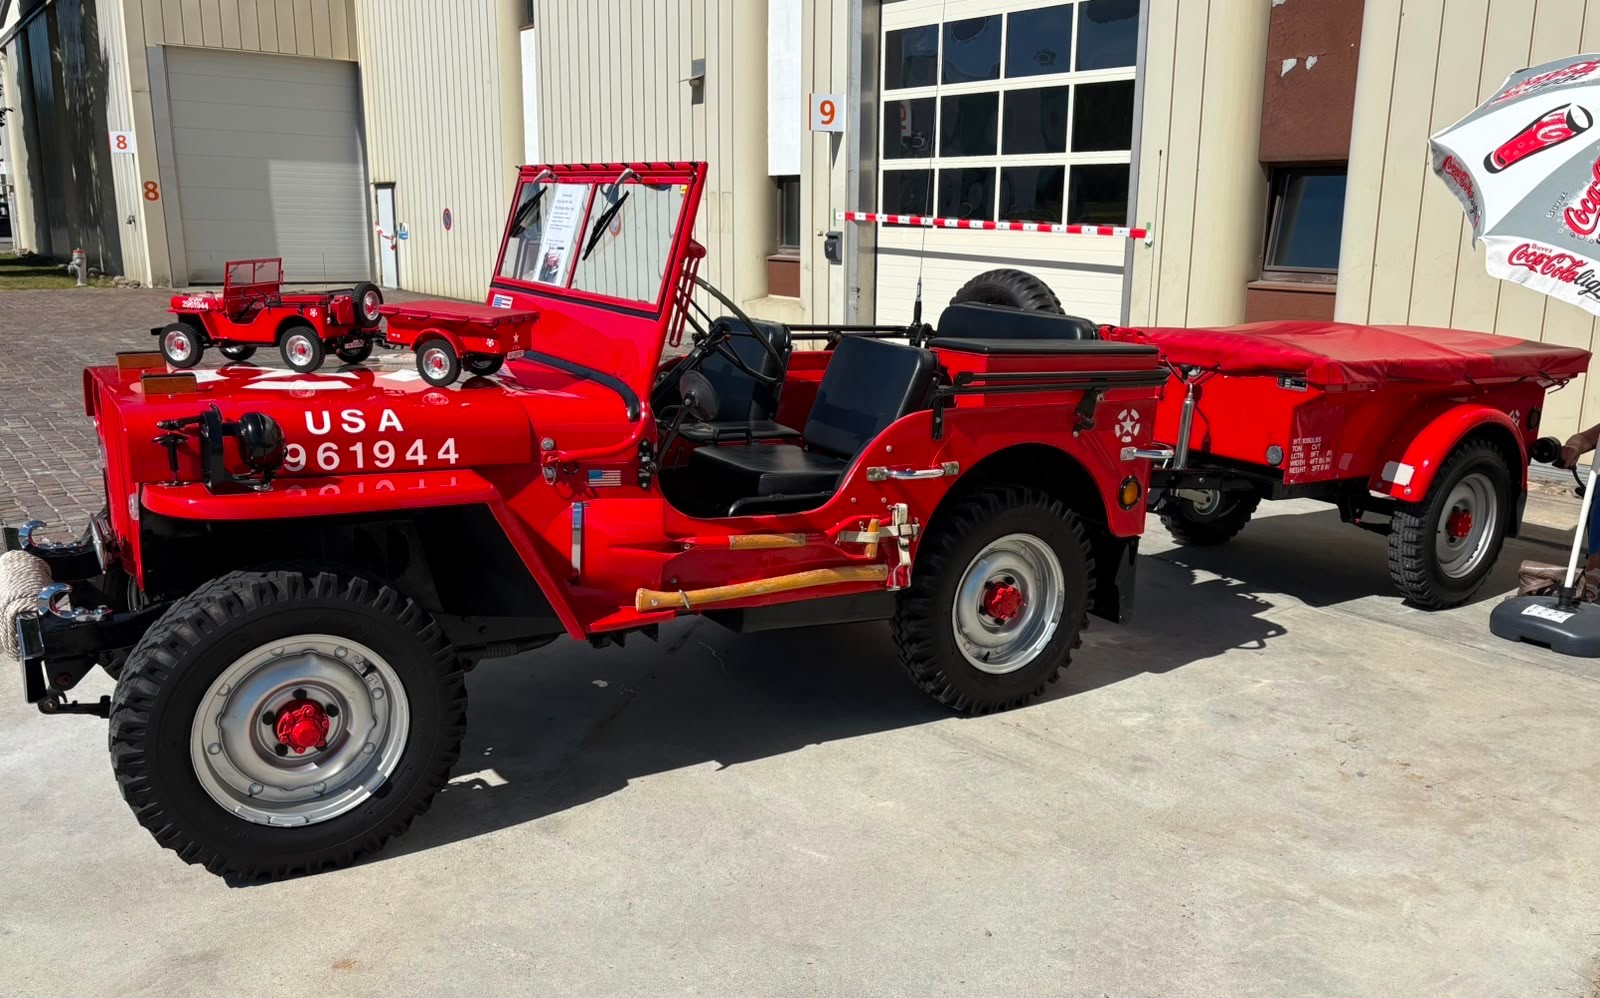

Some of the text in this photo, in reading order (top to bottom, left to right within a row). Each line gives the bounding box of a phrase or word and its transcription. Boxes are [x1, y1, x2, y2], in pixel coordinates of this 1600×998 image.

[820, 100, 836, 125] 9
[116, 135, 128, 150] 8
[143, 181, 160, 201] 8
[1531, 243, 1553, 254] Buvez
[1507, 243, 1600, 300] Coca-Cola lig
[304, 408, 404, 435] USA
